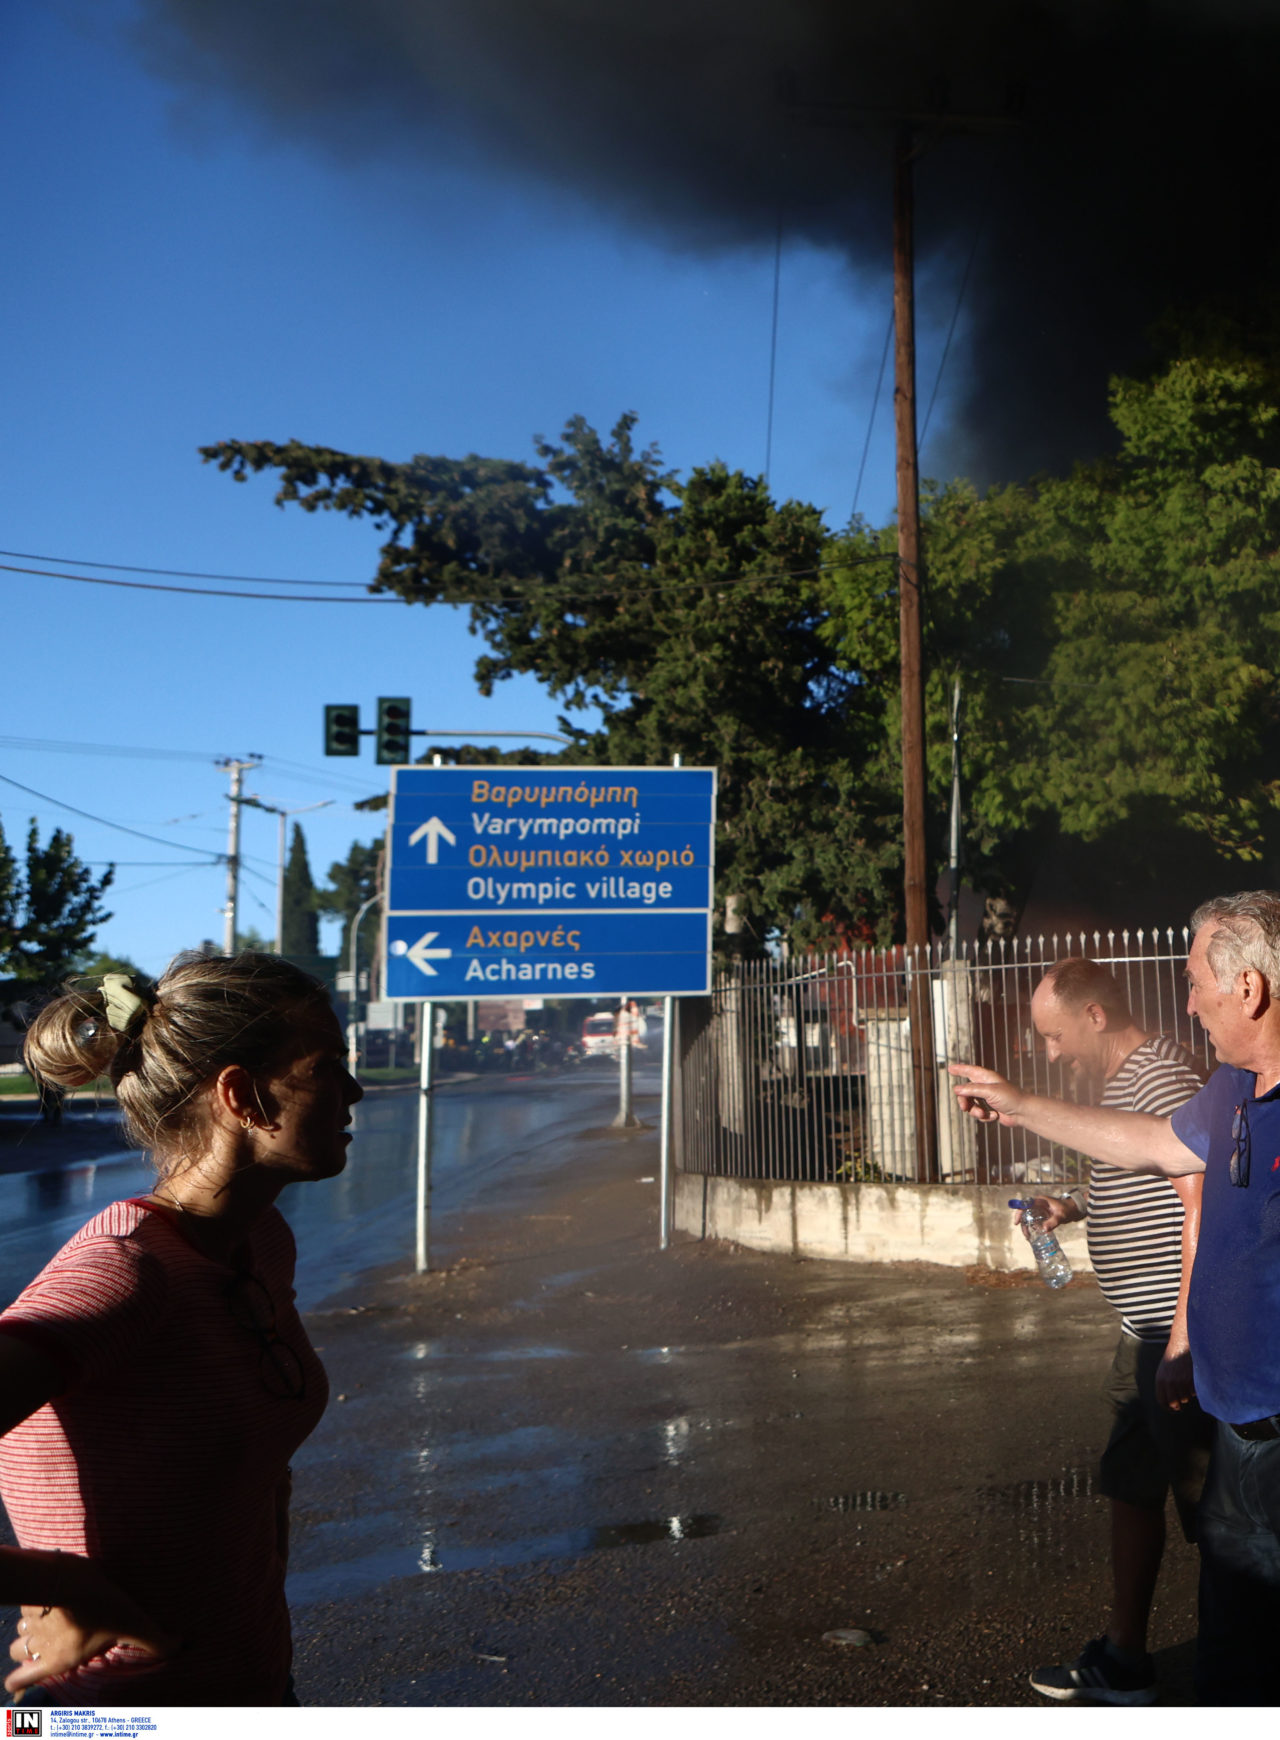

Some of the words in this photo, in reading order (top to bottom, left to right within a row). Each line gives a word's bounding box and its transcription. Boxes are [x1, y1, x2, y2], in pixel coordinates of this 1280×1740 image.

[471, 780, 639, 808] Βαρυμπόμπη
[471, 812, 641, 840] Varympompi
[468, 844, 610, 872] Ολυμπιακό
[619, 844, 695, 872] χωριό
[466, 877, 577, 904] Olympic
[585, 877, 673, 904] village
[465, 925, 581, 952] Αχαρνές
[464, 958, 596, 981] Acharnes
